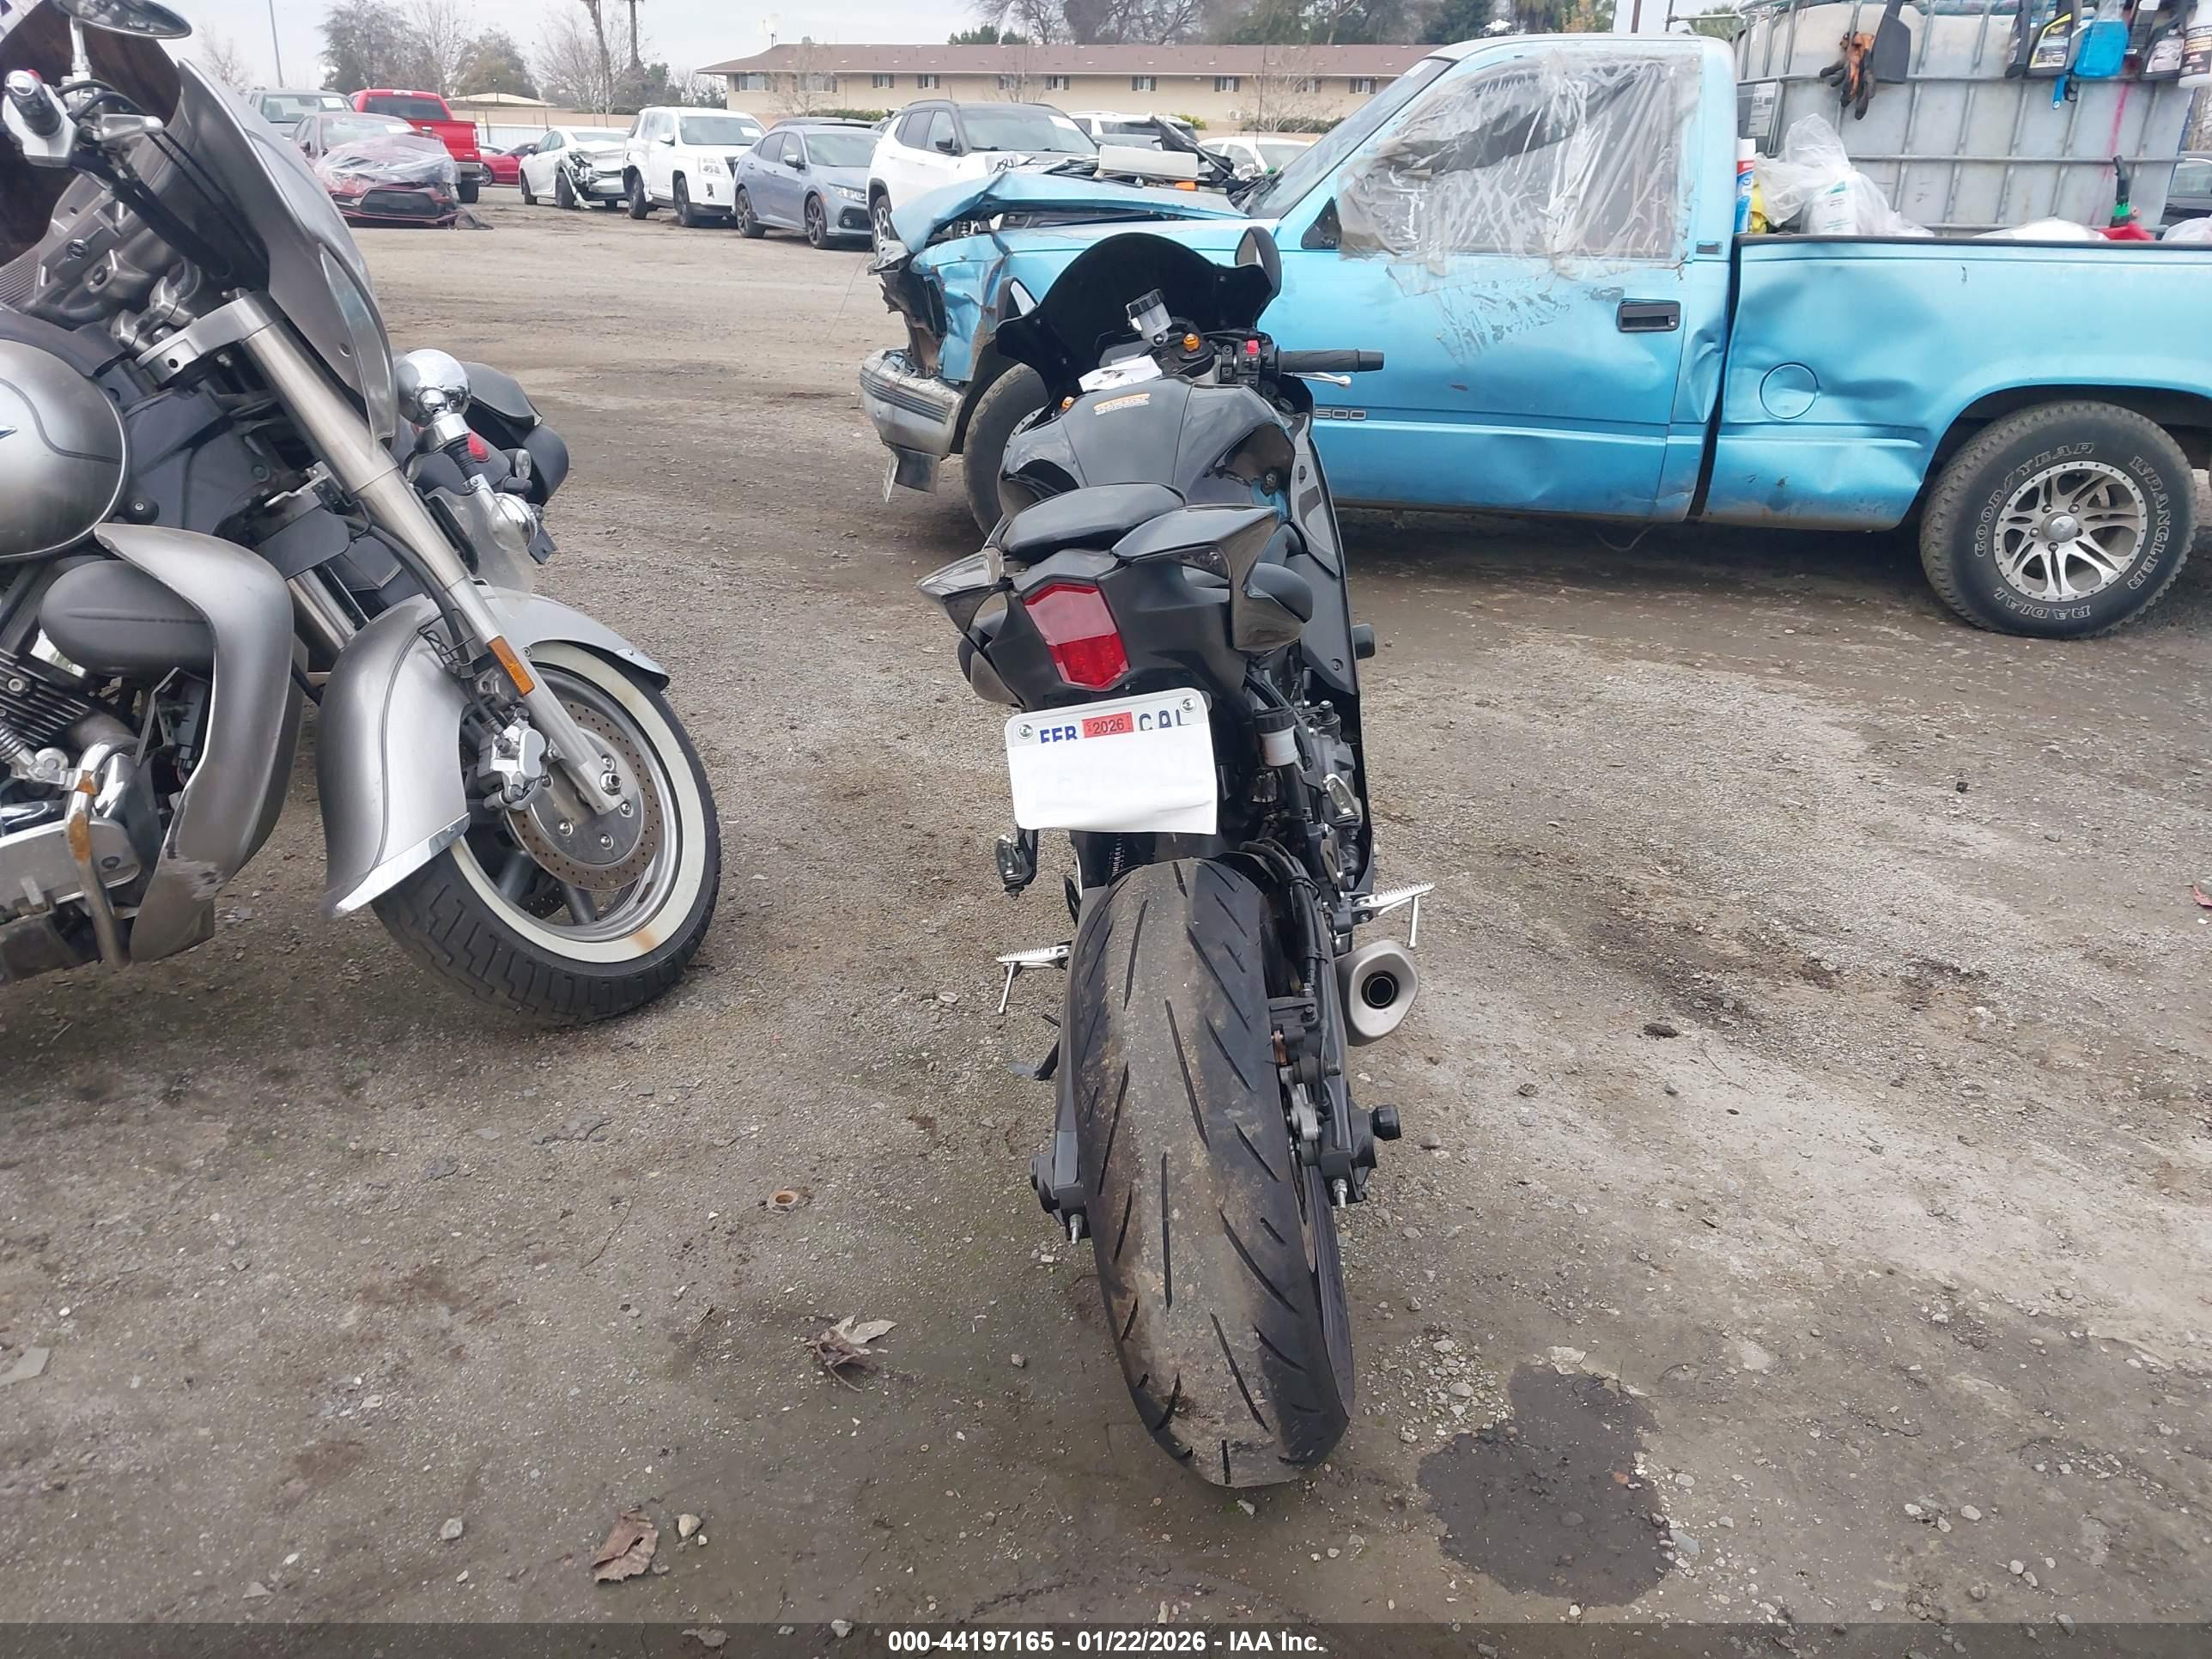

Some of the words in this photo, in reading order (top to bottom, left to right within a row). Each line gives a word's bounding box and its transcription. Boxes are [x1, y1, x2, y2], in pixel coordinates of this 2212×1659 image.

[1974, 442, 2094, 556] GOODYEAR
[2127, 455, 2170, 590] WRANGLER
[1992, 586, 2092, 620] RADIAL
[1092, 718, 1125, 735] 2026
